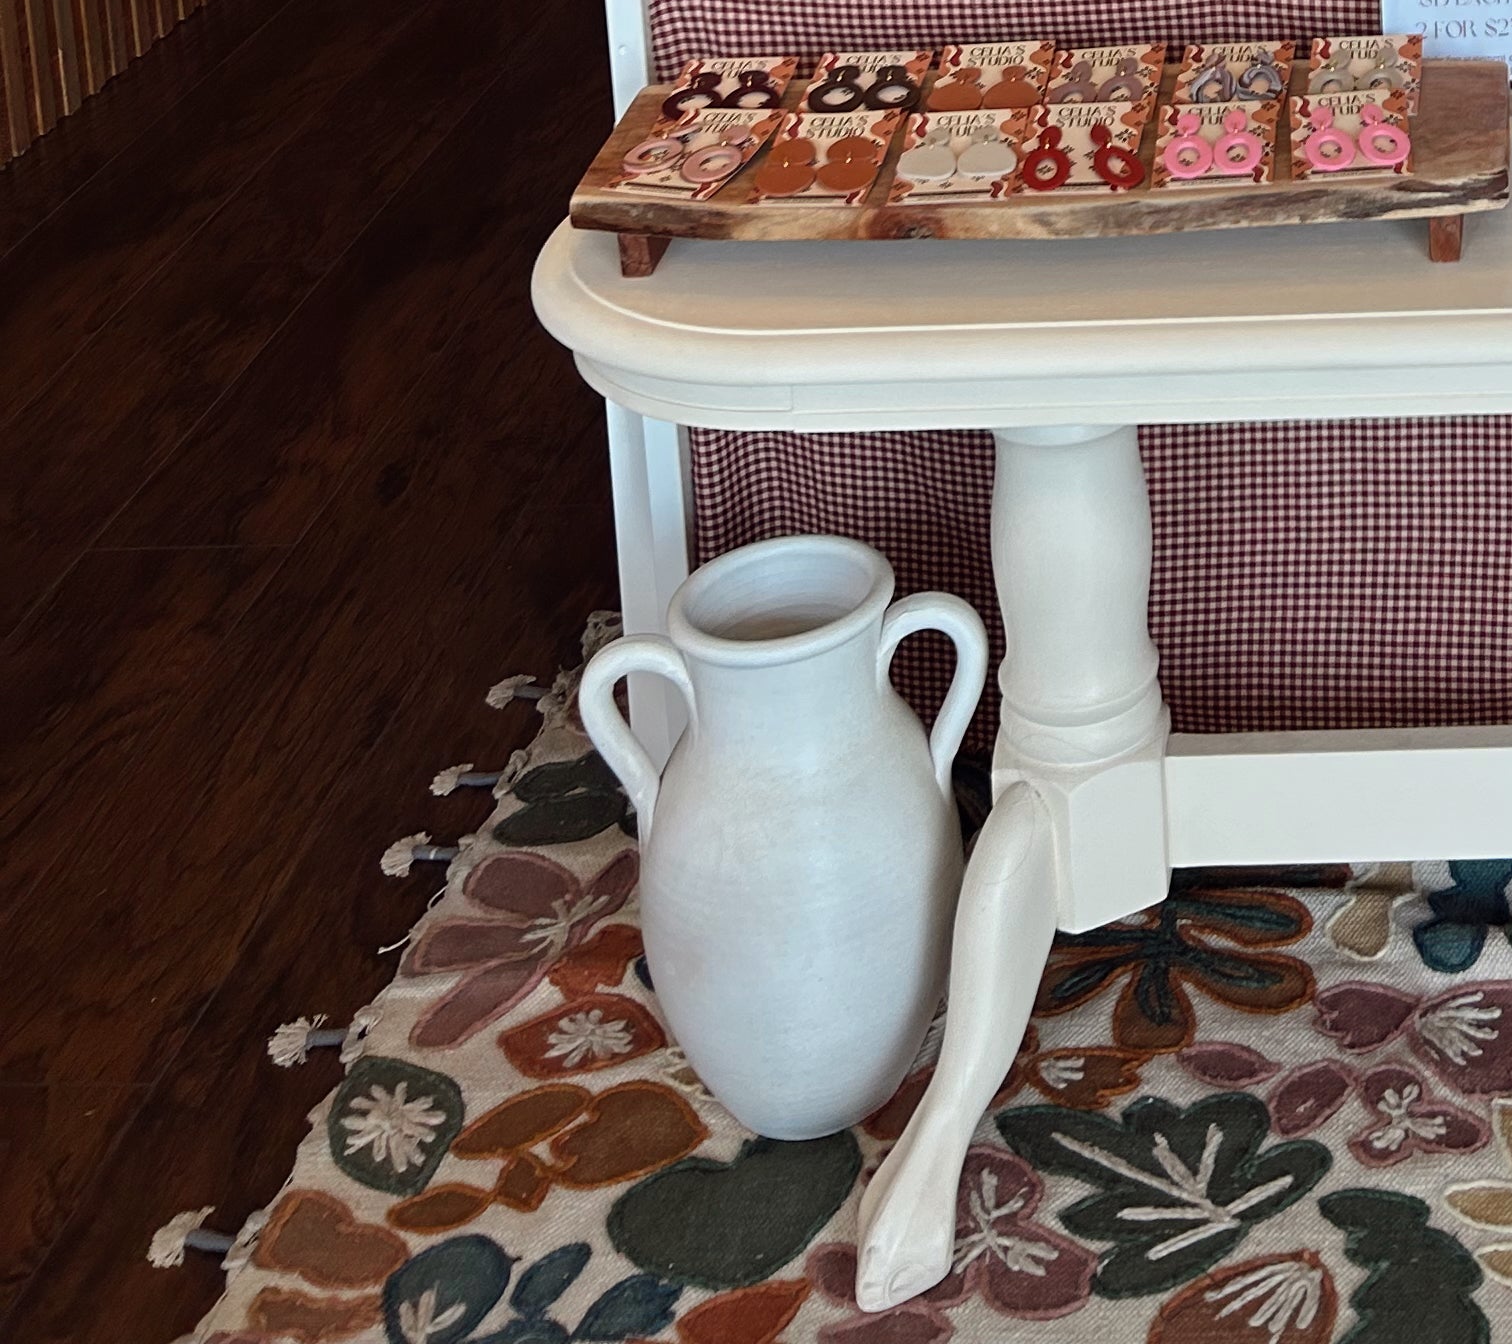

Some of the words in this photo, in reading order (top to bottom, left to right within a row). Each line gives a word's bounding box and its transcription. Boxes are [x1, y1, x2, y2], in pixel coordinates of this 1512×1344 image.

[1415, 21, 1428, 39] 2
[1434, 20, 1477, 40] FOR
[970, 44, 1026, 58] CELIA'S
[1338, 38, 1394, 51] CELIA'S
[967, 55, 1024, 67] STUDIO
[1081, 48, 1138, 60] CELIA'S
[1317, 93, 1376, 107] CELIA'S
[1058, 105, 1117, 119] CELIA'S
[809, 114, 869, 128] CELIA'S
[936, 113, 998, 128] CELIA'S
